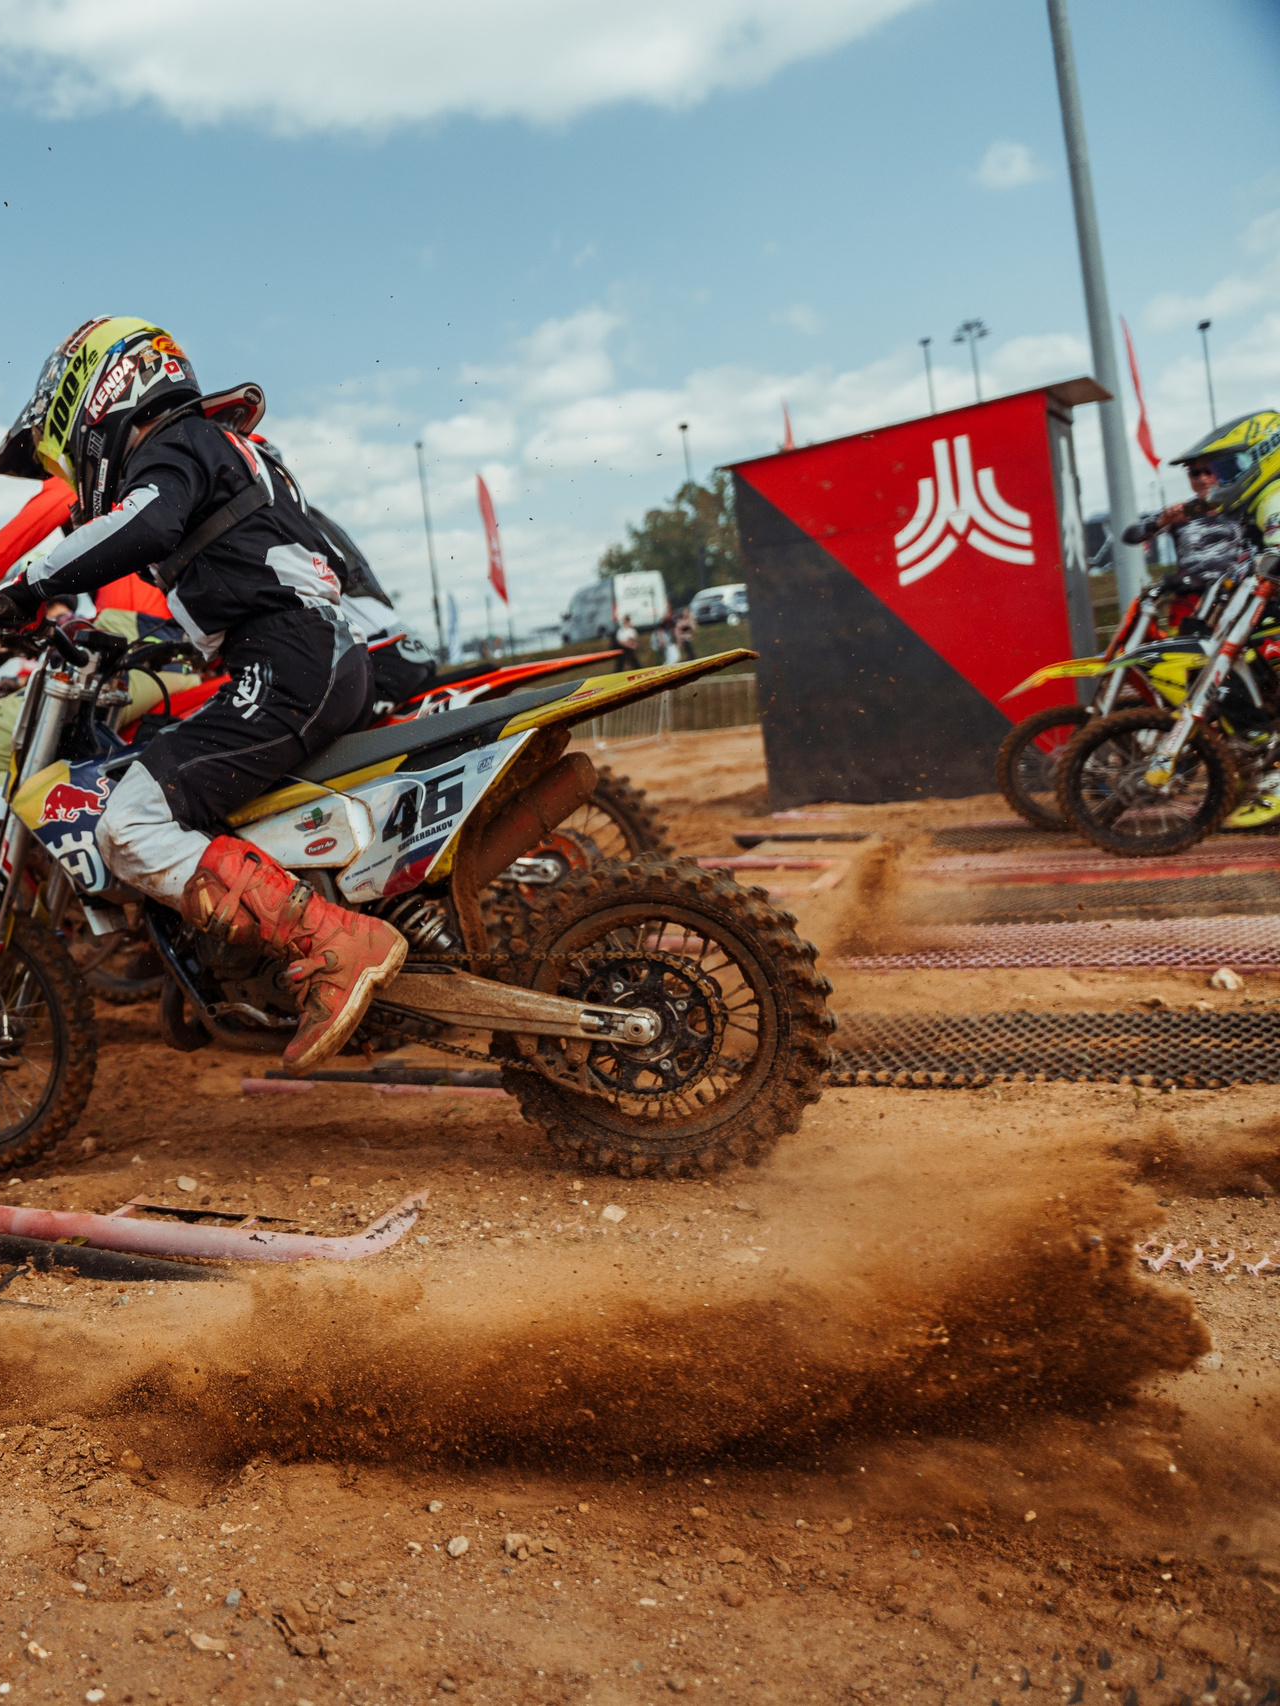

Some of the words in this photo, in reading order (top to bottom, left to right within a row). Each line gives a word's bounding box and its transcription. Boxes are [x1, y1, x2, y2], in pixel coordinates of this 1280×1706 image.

[48, 343, 99, 446] 100%
[88, 358, 135, 420] KENDA
[382, 765, 466, 843] 46
[307, 844, 325, 854] Twin
[324, 840, 335, 848] Air
